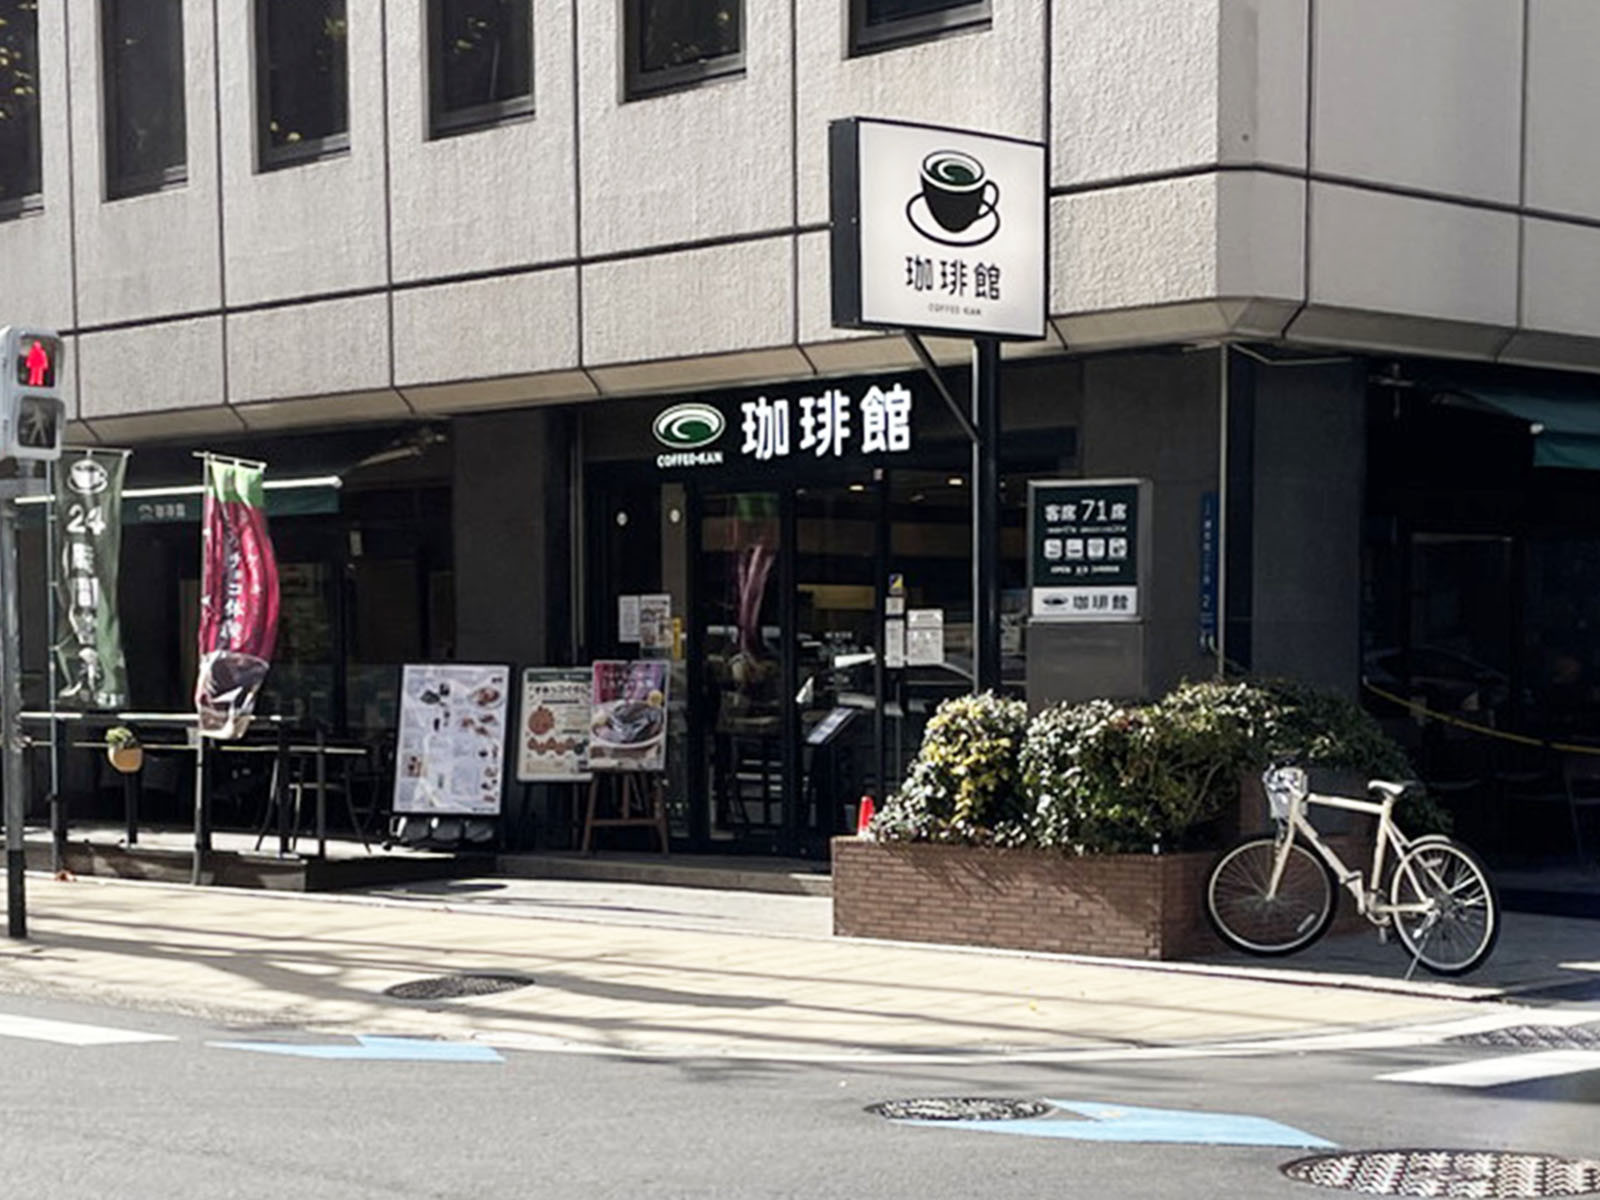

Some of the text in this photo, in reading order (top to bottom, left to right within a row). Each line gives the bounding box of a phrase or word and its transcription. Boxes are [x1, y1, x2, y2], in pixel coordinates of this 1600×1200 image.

[905, 255, 1001, 301] 珈琲館
[740, 383, 912, 461] 珈琲館
